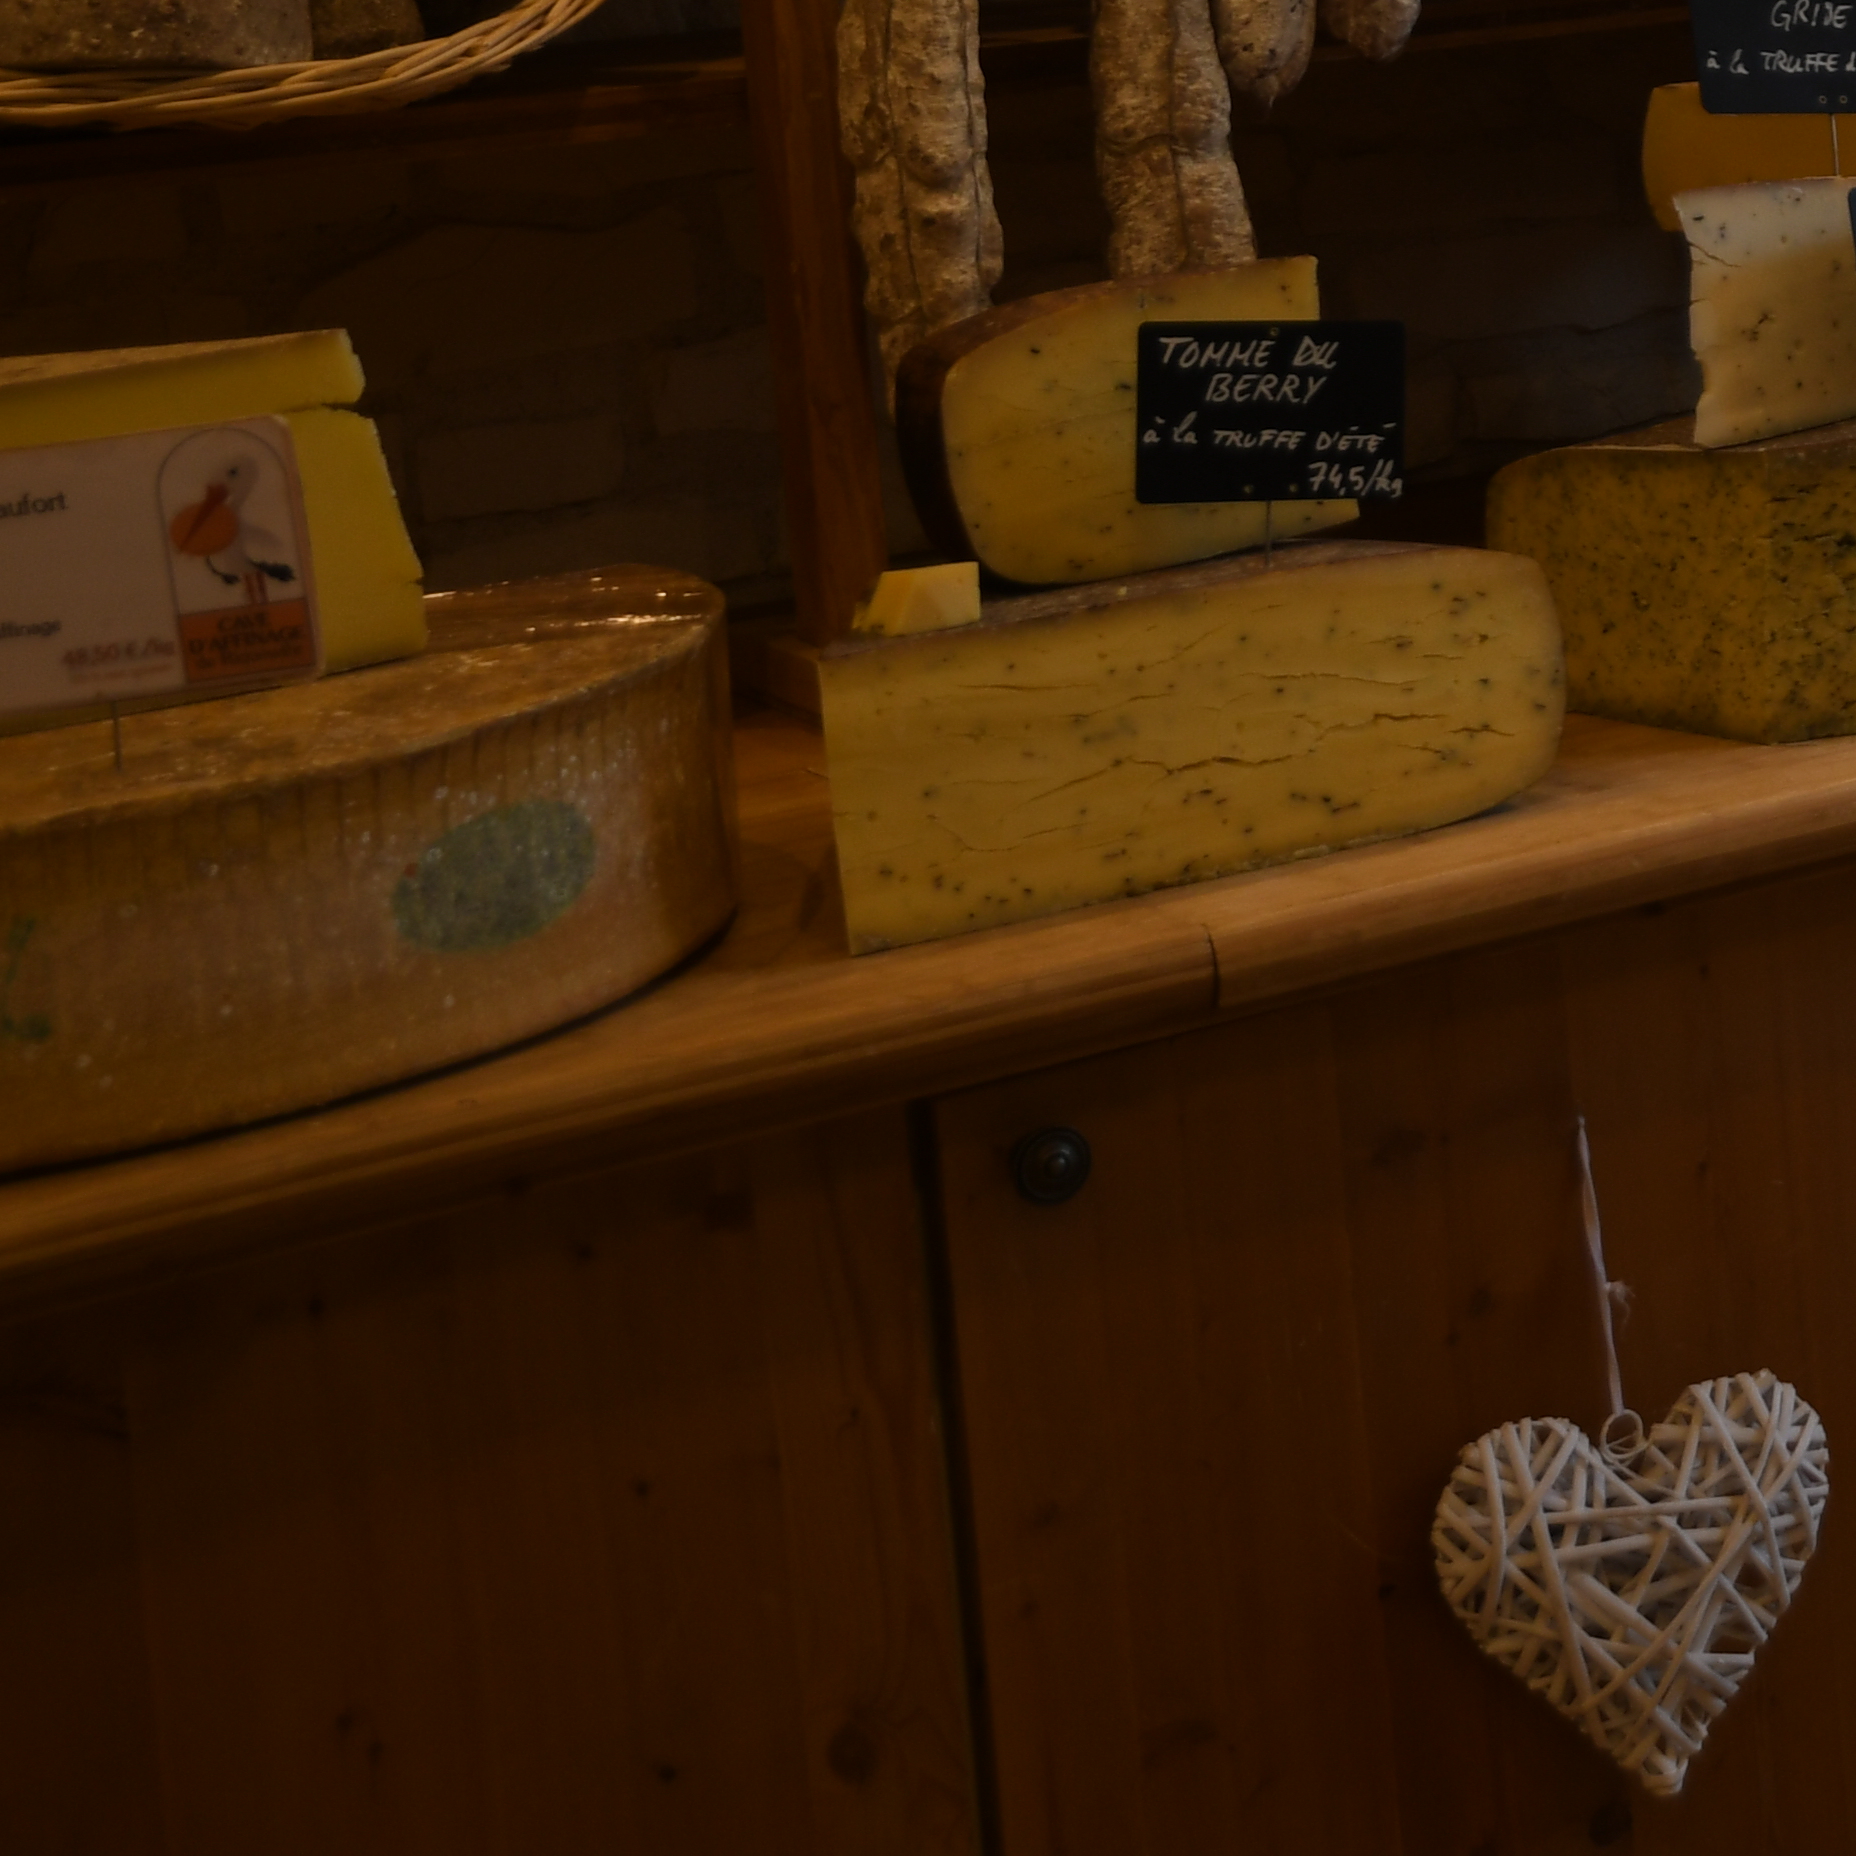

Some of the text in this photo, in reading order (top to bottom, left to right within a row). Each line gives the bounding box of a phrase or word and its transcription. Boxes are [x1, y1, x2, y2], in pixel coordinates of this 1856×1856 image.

[1158, 335, 1339, 370] TOMME DU
[1204, 372, 1328, 404] BERRY
[1212, 428, 1308, 450] TRUFFE
